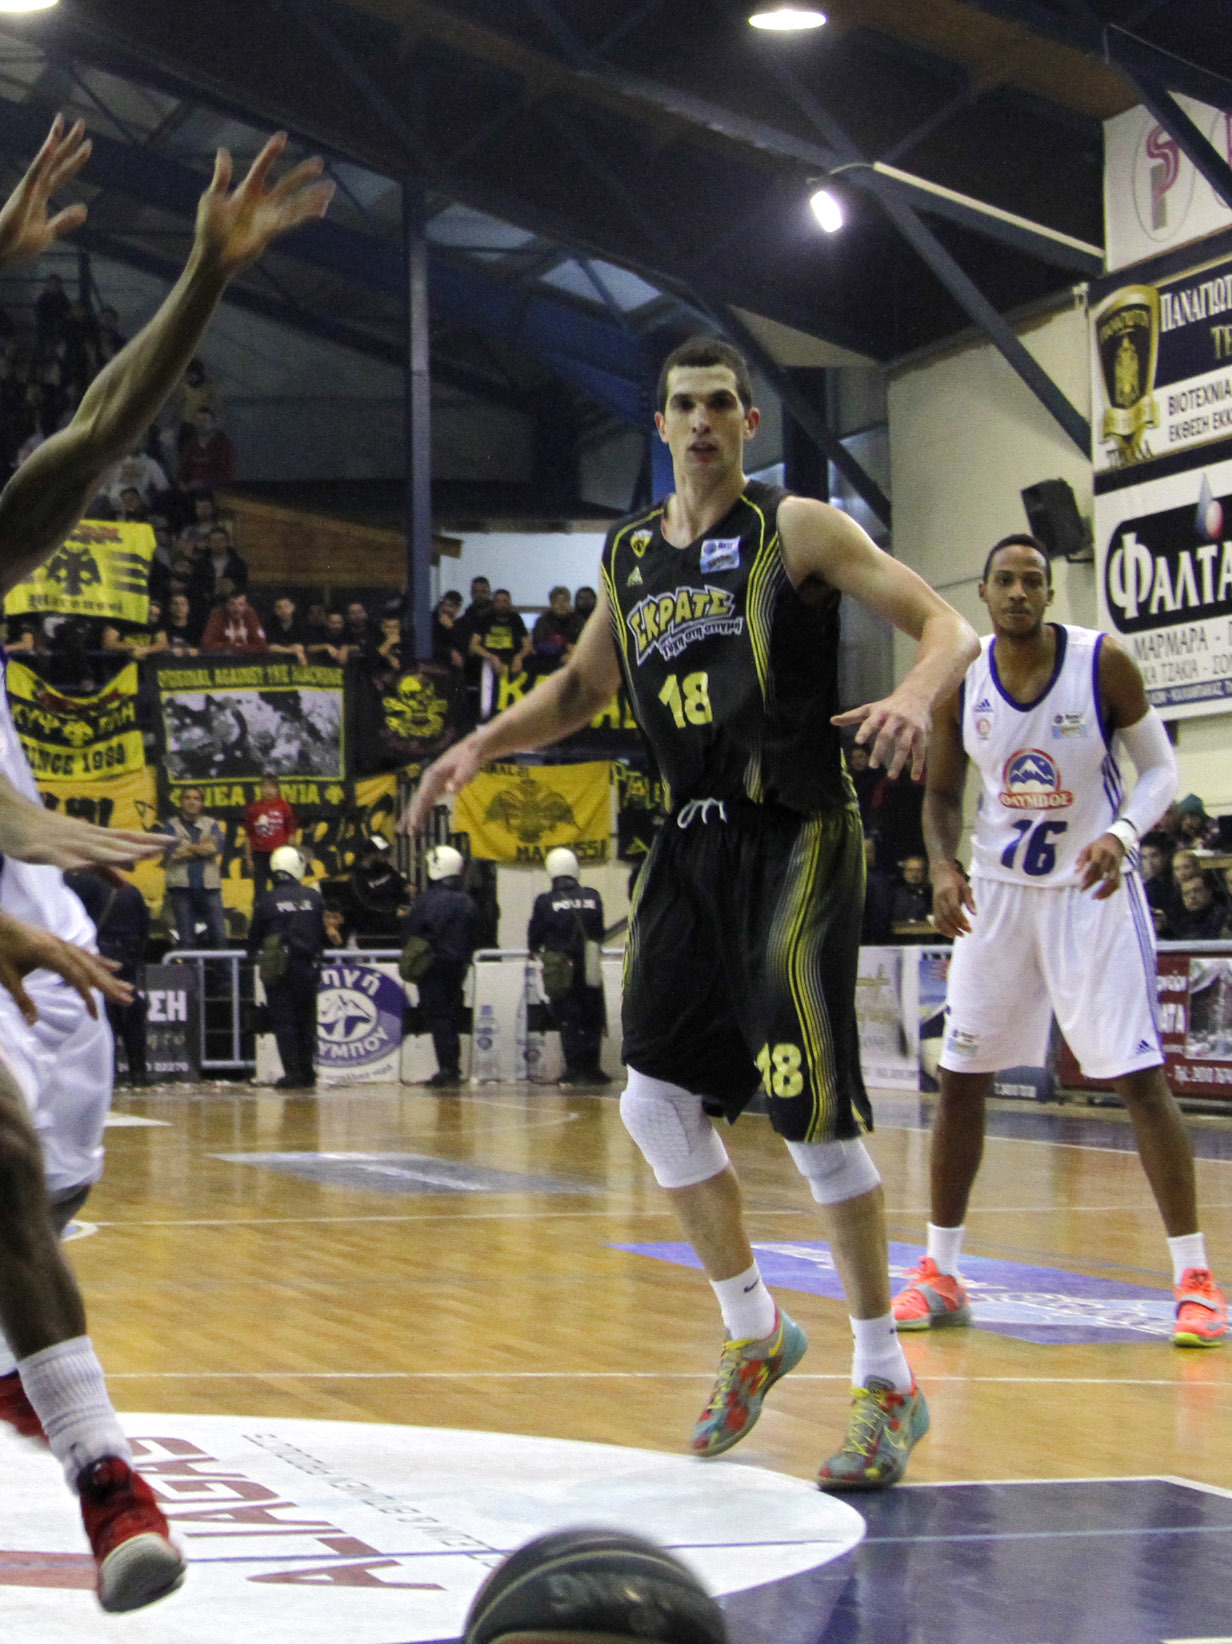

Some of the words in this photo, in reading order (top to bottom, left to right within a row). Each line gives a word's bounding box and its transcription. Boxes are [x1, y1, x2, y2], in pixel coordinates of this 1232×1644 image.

[1134, 626, 1209, 661] ΜΑΡΜΑΡΑ
[658, 671, 713, 728] 18
[25, 745, 74, 776] INCE
[320, 967, 382, 996] ηγή
[146, 990, 187, 1022] ΣΗ
[318, 1026, 389, 1058] ΥΜΠΟΥ
[757, 1042, 805, 1098] 18
